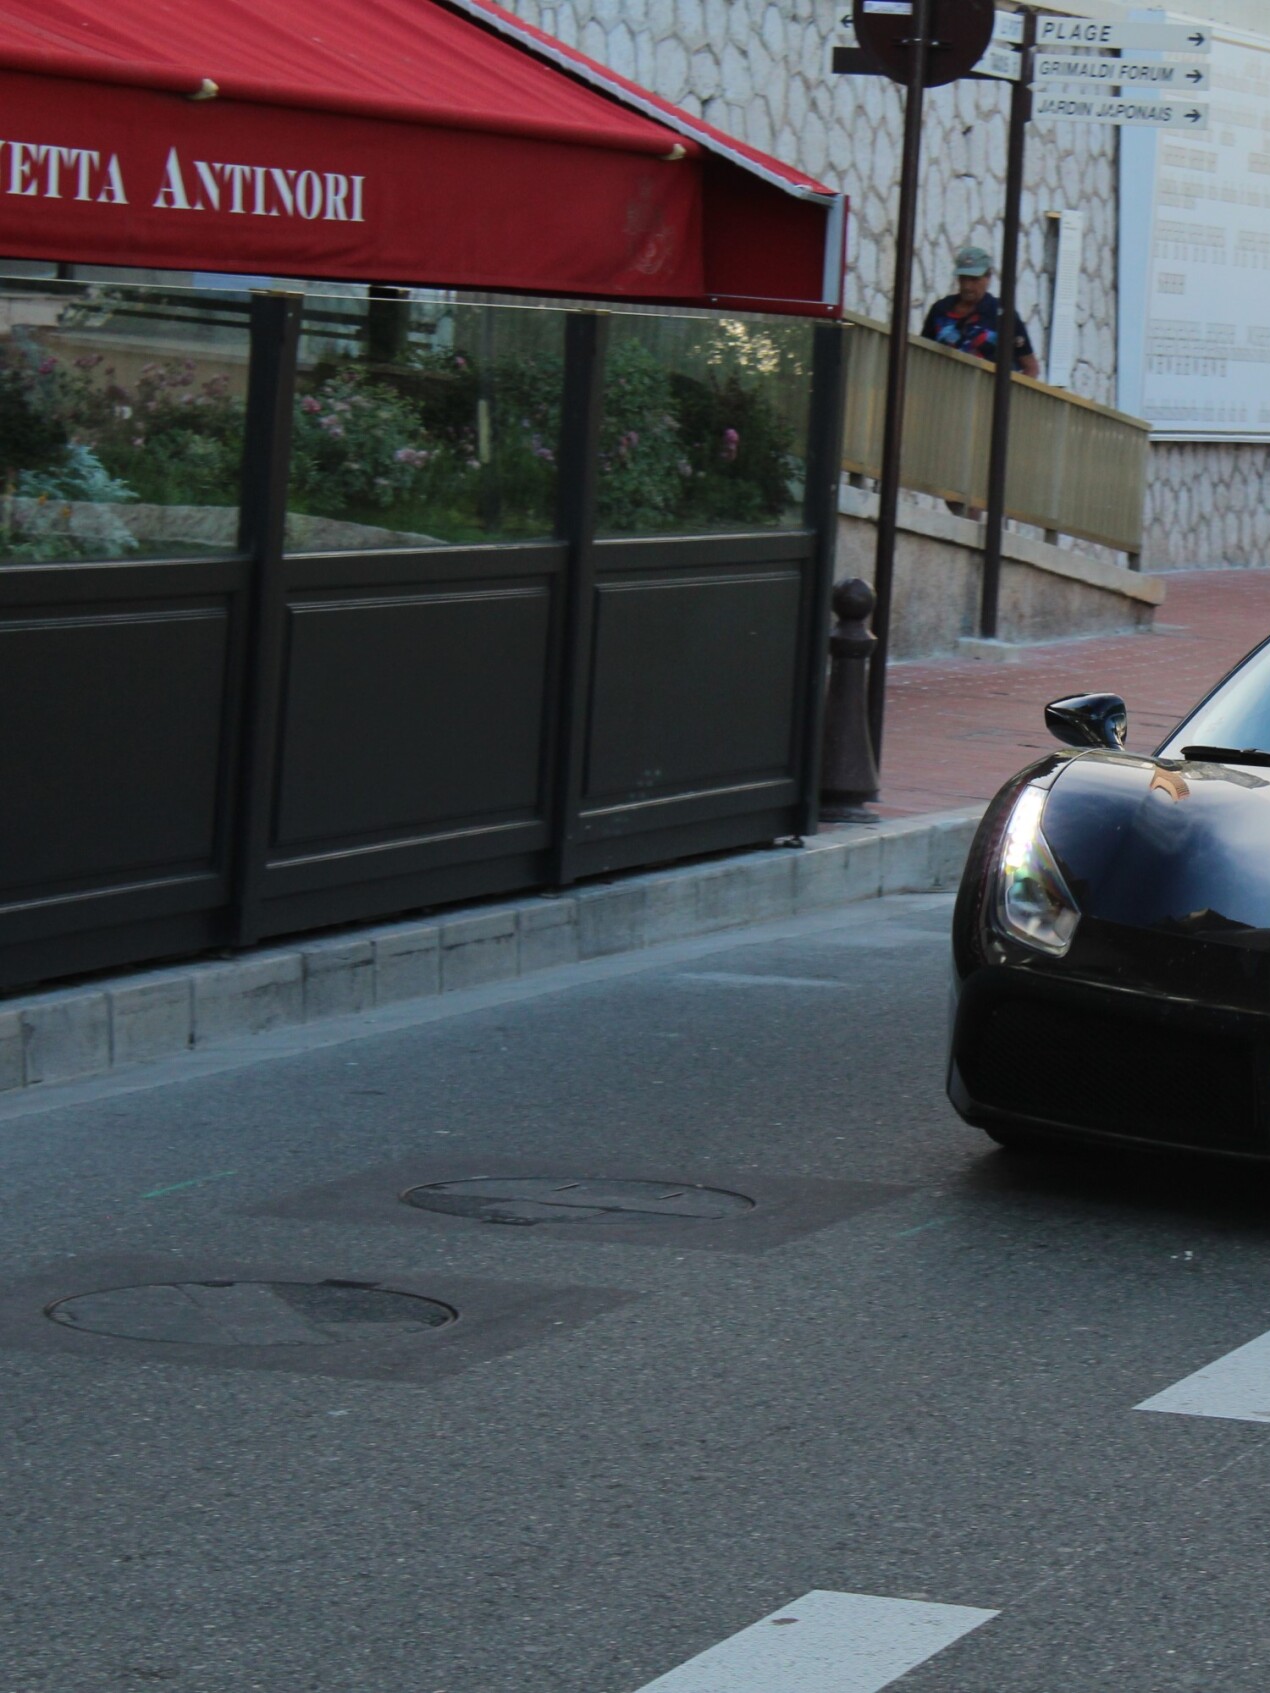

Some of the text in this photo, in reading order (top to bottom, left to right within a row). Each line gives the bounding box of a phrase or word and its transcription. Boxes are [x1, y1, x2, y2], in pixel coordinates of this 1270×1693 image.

[1042, 22, 1112, 42] PLAGE
[1039, 61, 1115, 79] GRIMALDI
[1118, 65, 1175, 82] FORUM
[1037, 100, 1172, 121] JARDIN JAPONAIS
